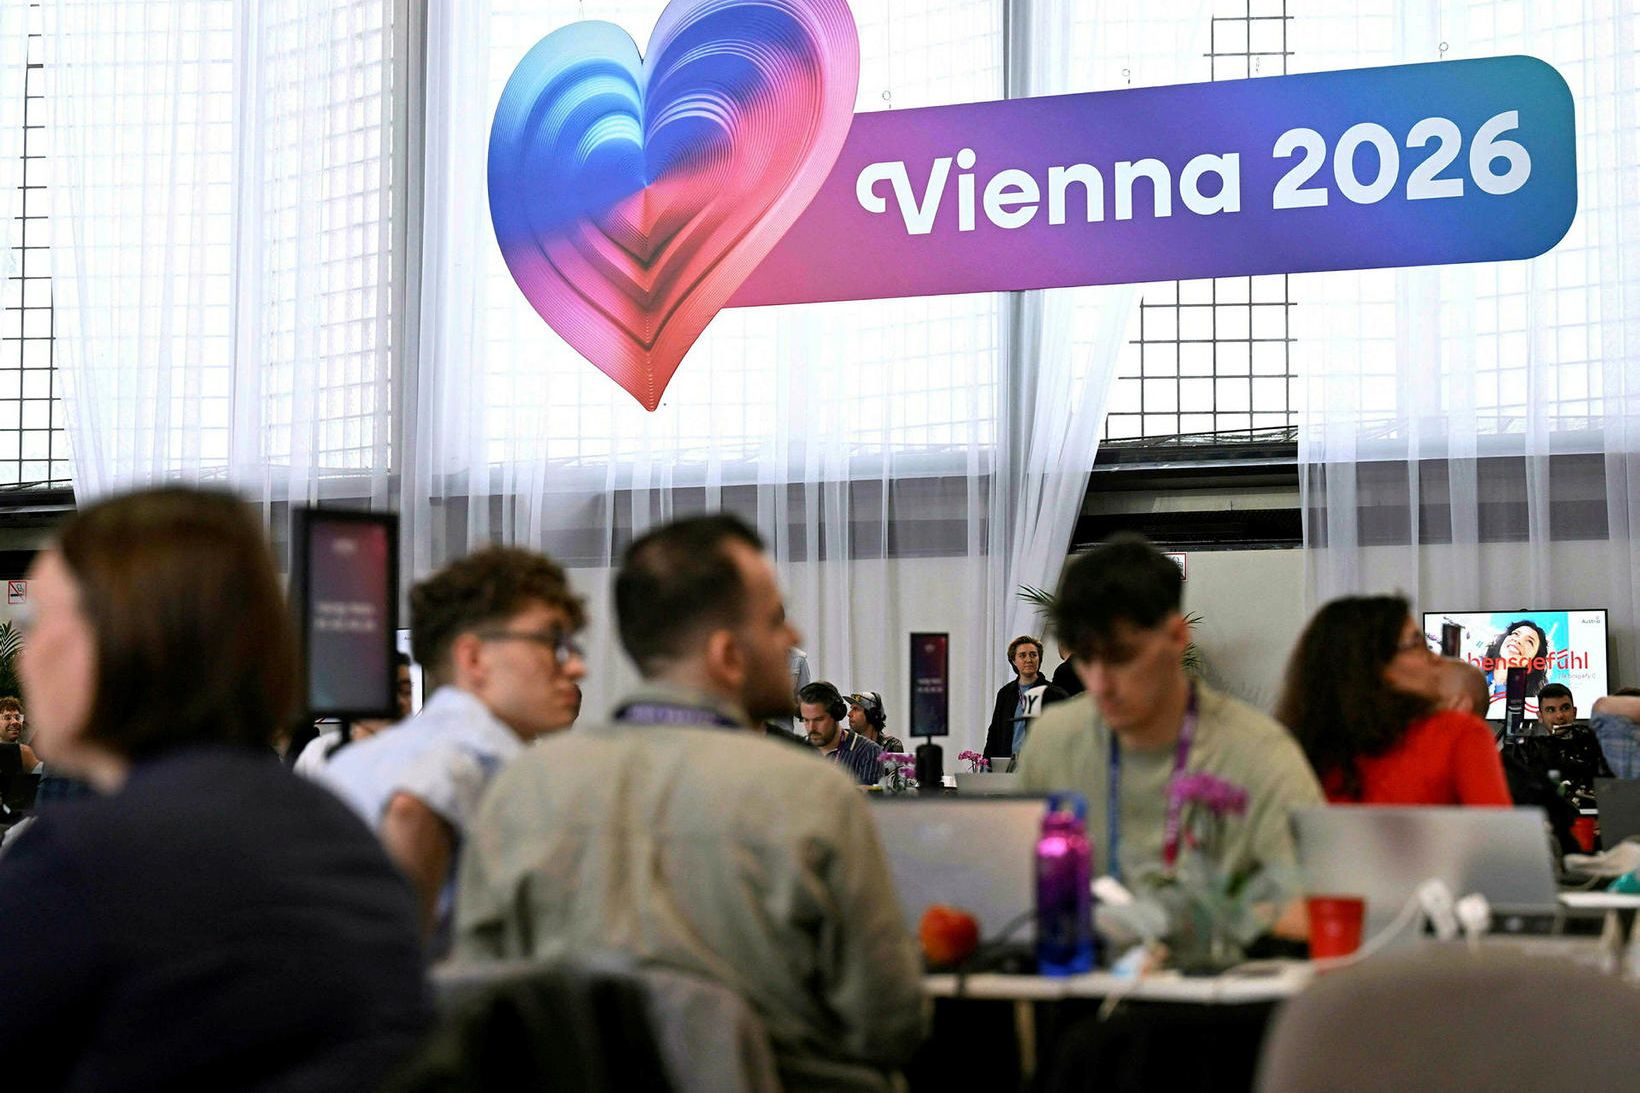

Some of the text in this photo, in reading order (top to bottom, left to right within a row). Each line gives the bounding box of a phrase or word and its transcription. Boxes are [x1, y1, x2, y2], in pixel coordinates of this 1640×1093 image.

[856, 110, 1531, 235] Vienna 2026
[1461, 649, 1589, 675] bensgefühl
